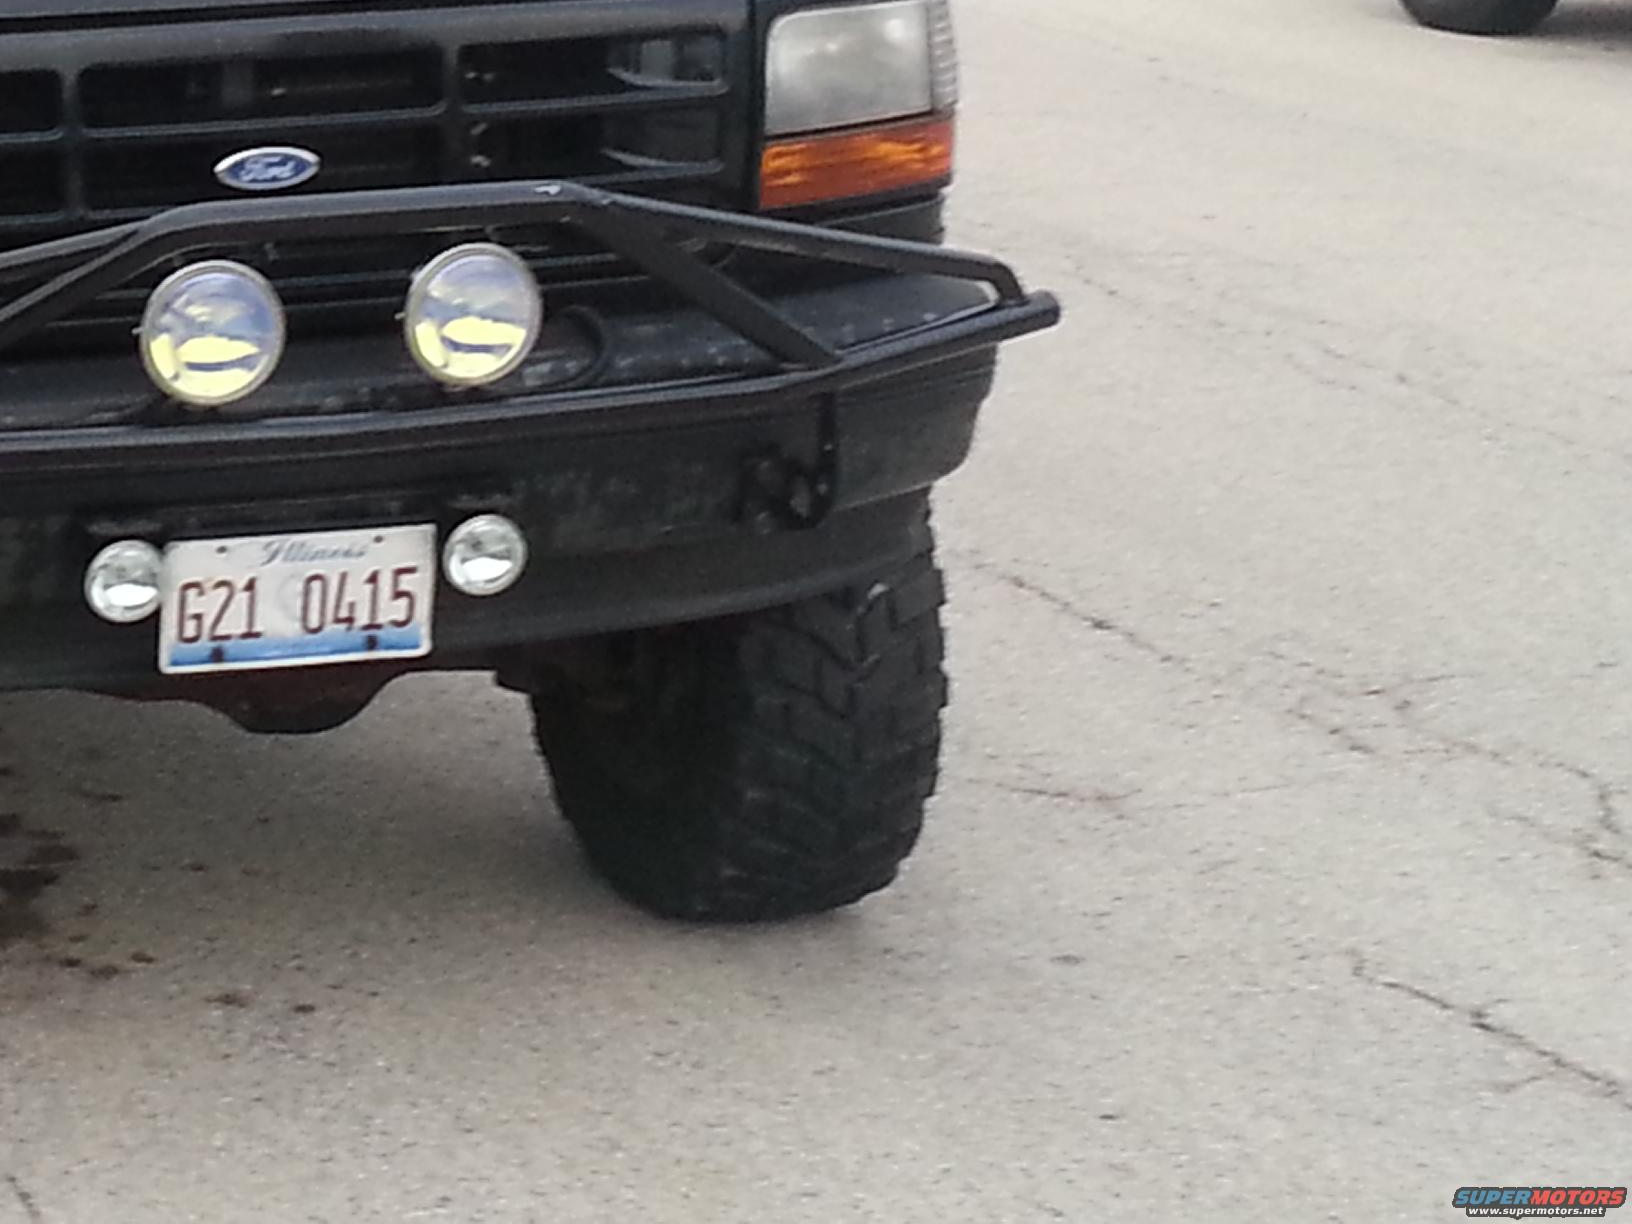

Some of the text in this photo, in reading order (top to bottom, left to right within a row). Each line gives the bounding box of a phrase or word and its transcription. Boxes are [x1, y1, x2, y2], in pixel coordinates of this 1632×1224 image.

[239, 155, 296, 183] Ford
[257, 538, 369, 567] Illinois
[177, 565, 418, 645] G21 0415
